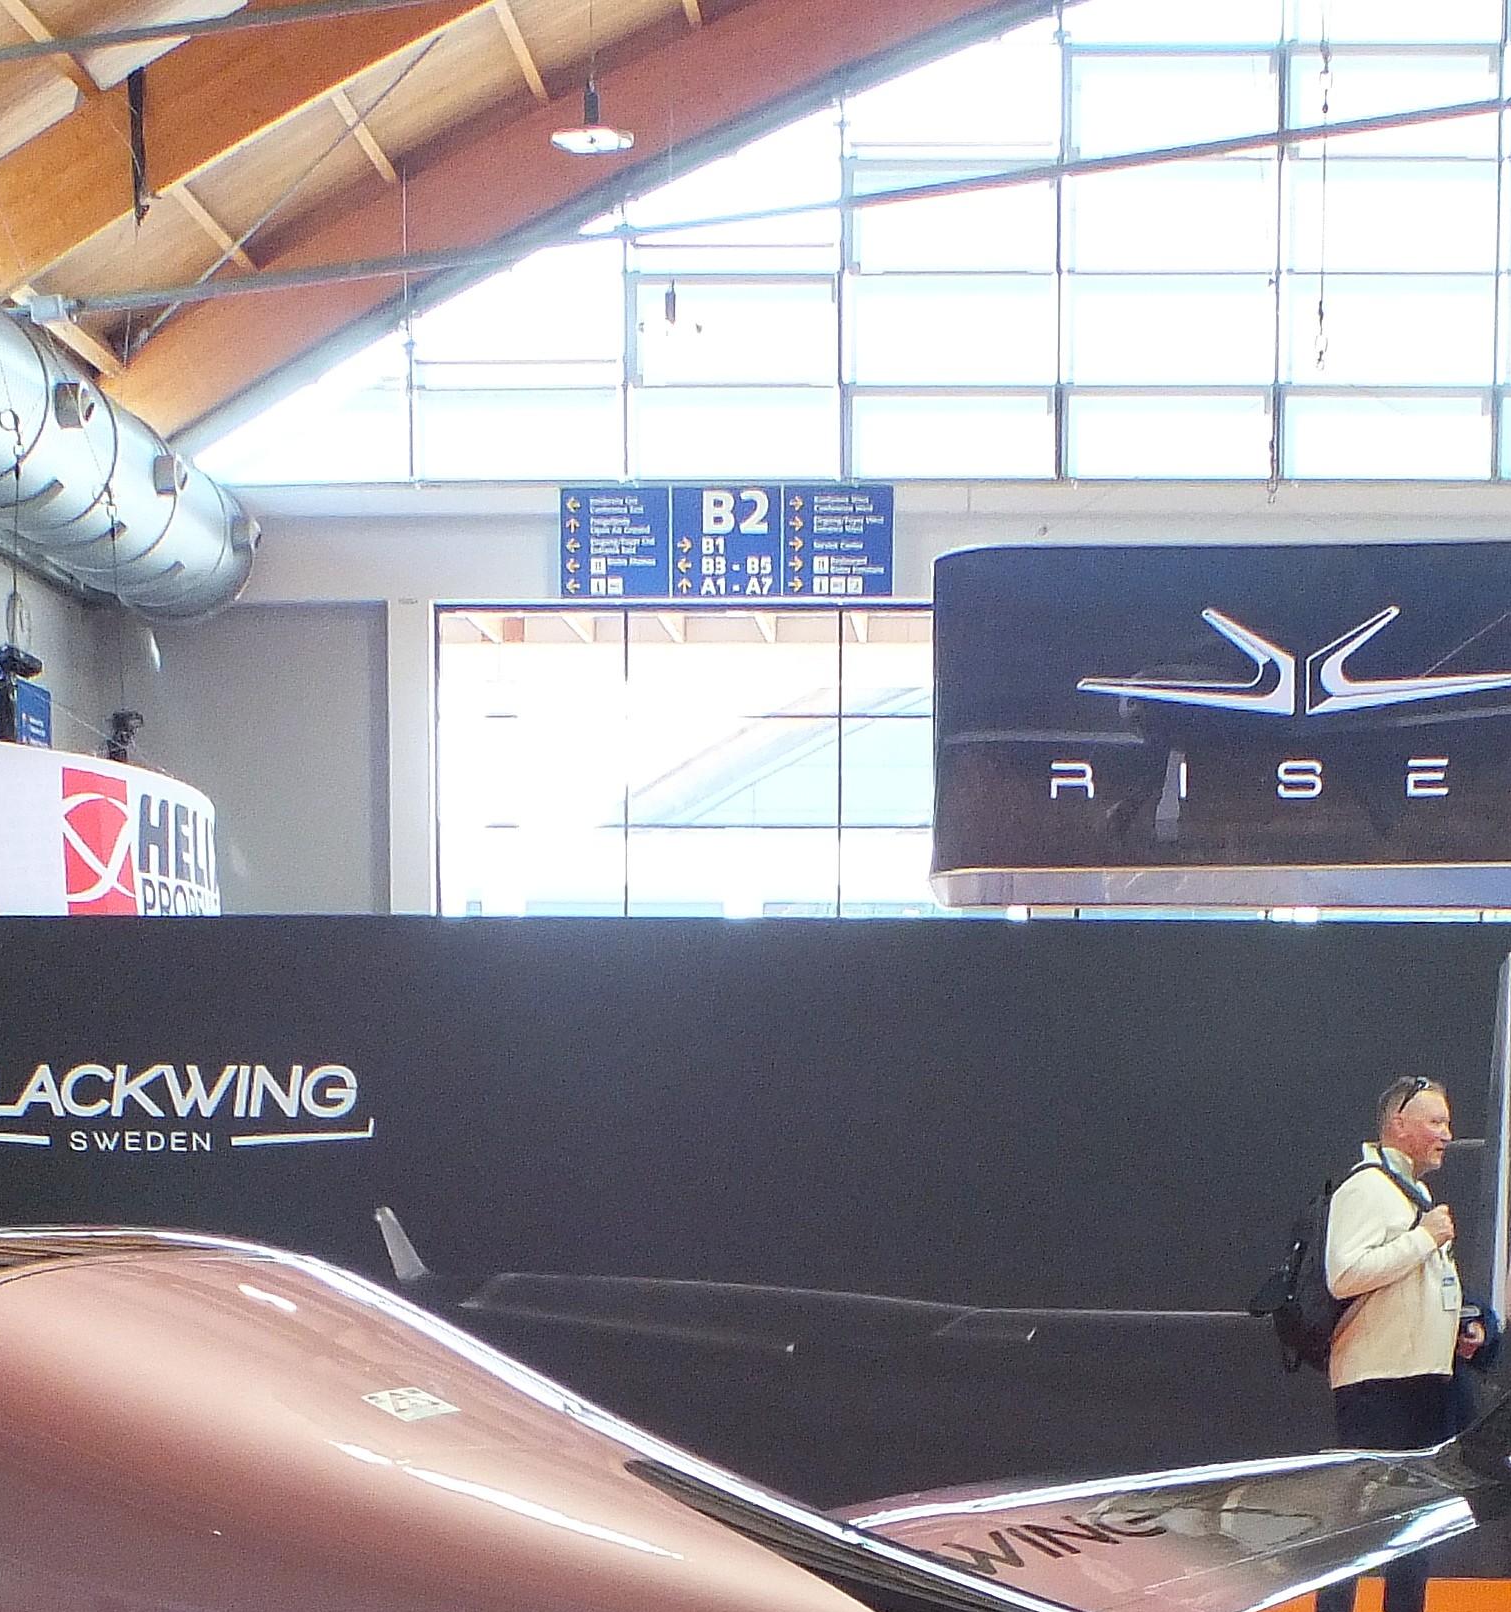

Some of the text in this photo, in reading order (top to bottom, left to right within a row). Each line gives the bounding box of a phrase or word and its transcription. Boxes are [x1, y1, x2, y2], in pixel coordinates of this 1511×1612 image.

[702, 490, 769, 535] B2
[701, 536, 725, 555] B1
[701, 555, 727, 575] B3
[746, 555, 772, 575] B5
[700, 577, 726, 596] A1
[745, 576, 773, 596] A7
[139, 793, 218, 893] HELI
[68, 1130, 214, 1153] SWEDEN
